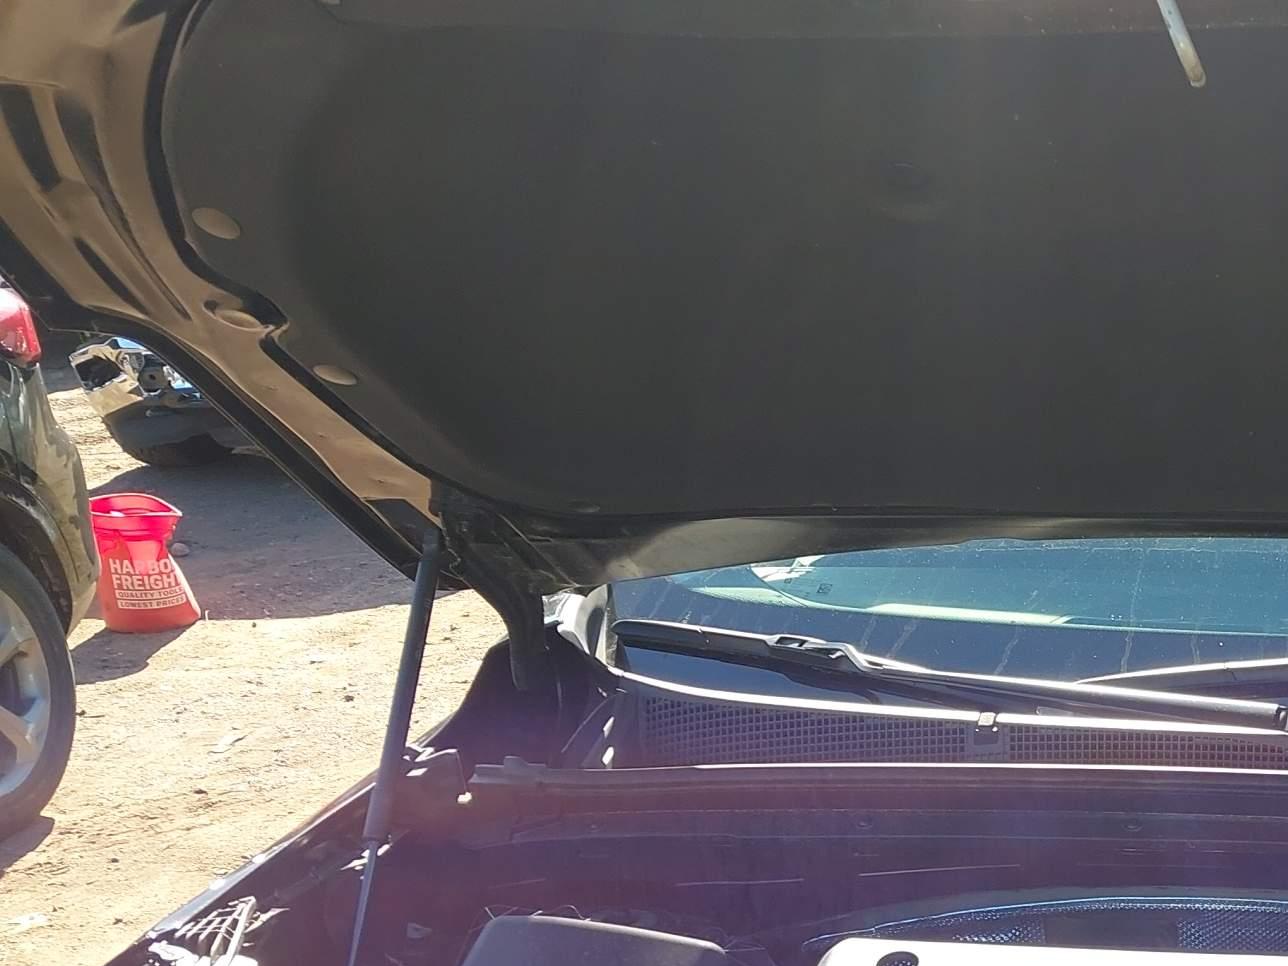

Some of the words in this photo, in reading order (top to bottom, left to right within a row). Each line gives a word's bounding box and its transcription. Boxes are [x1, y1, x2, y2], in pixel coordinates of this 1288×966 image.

[109, 558, 175, 574] HARBO
[118, 590, 155, 599] QUALITY
[120, 600, 154, 608] LOWEST
